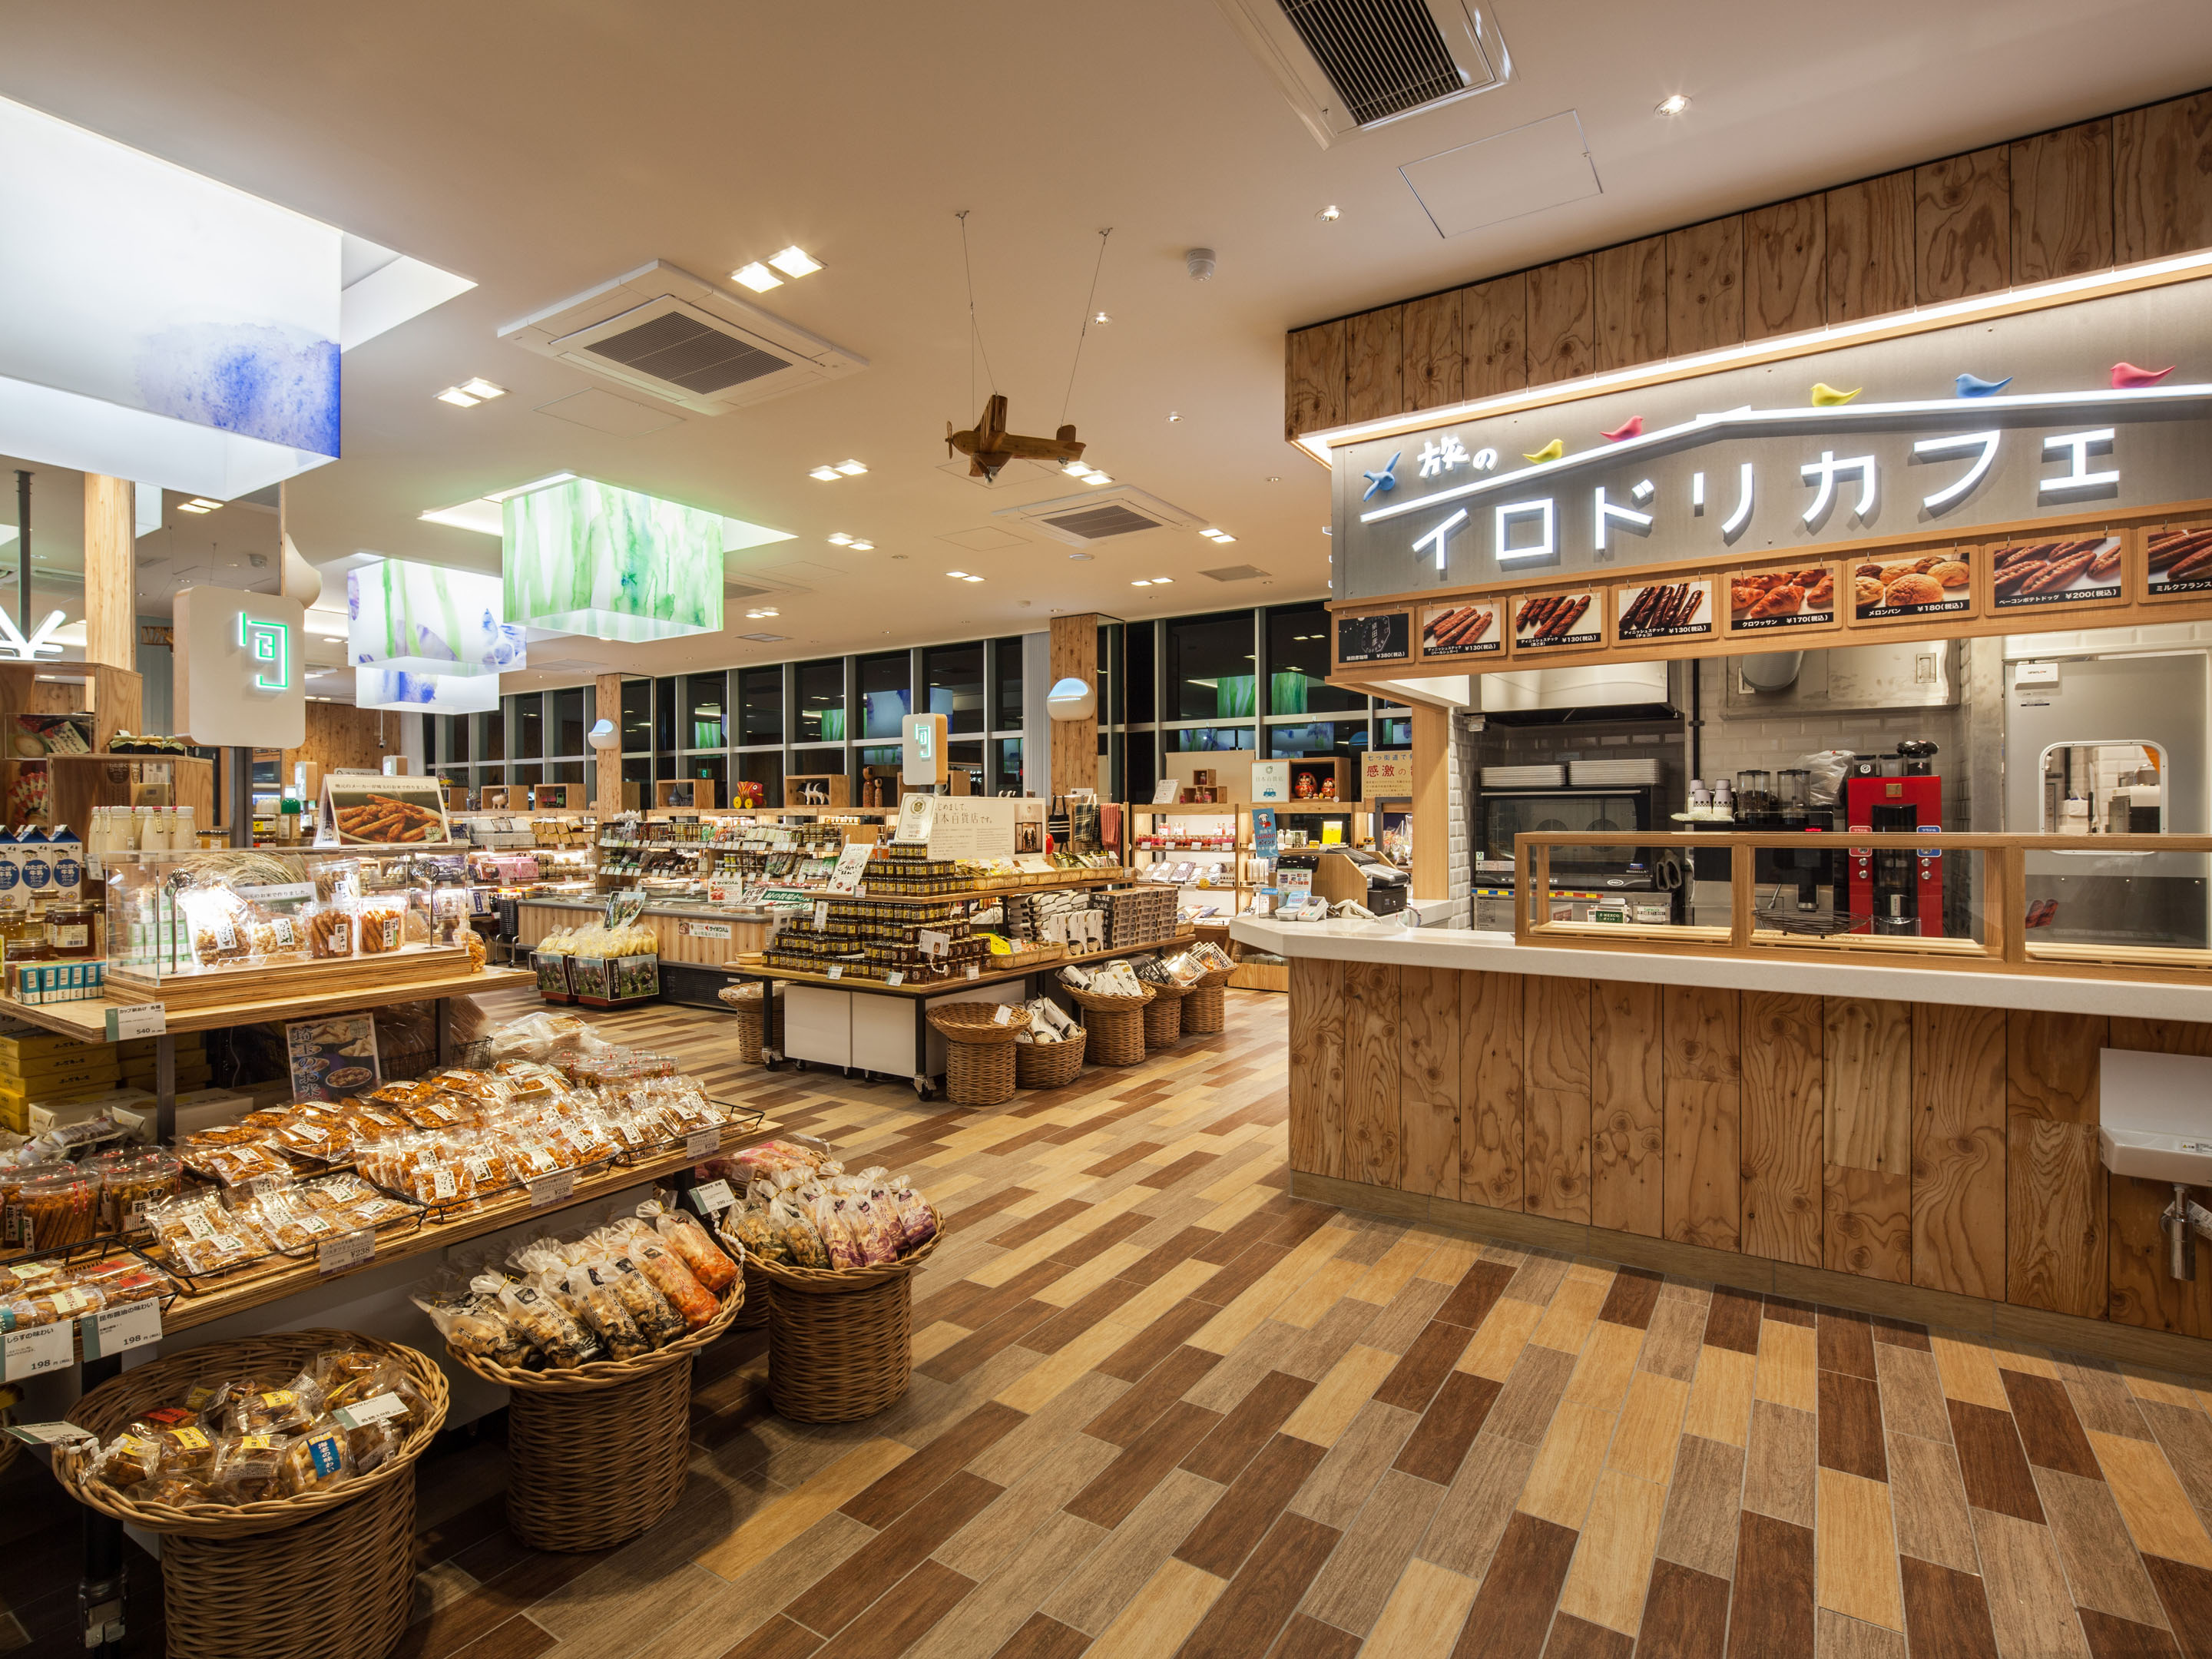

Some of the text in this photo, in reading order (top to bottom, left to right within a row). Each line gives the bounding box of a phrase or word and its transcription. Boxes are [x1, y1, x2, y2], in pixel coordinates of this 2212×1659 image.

[1416, 433, 1498, 478] 旅の
[1412, 428, 2120, 570] イロドリカフェ
[2155, 580, 2212, 593] ミルクフランス
[1998, 594, 2059, 604] ベーコンポテトドッグ
[1742, 619, 1777, 628] クロワッサン
[1366, 765, 1412, 777] 感激の
[294, 1026, 322, 1101] 埼玉のお米
[7, 1327, 54, 1344] しらすの味わい
[124, 1335, 141, 1346] 198
[31, 1359, 51, 1370] 198
